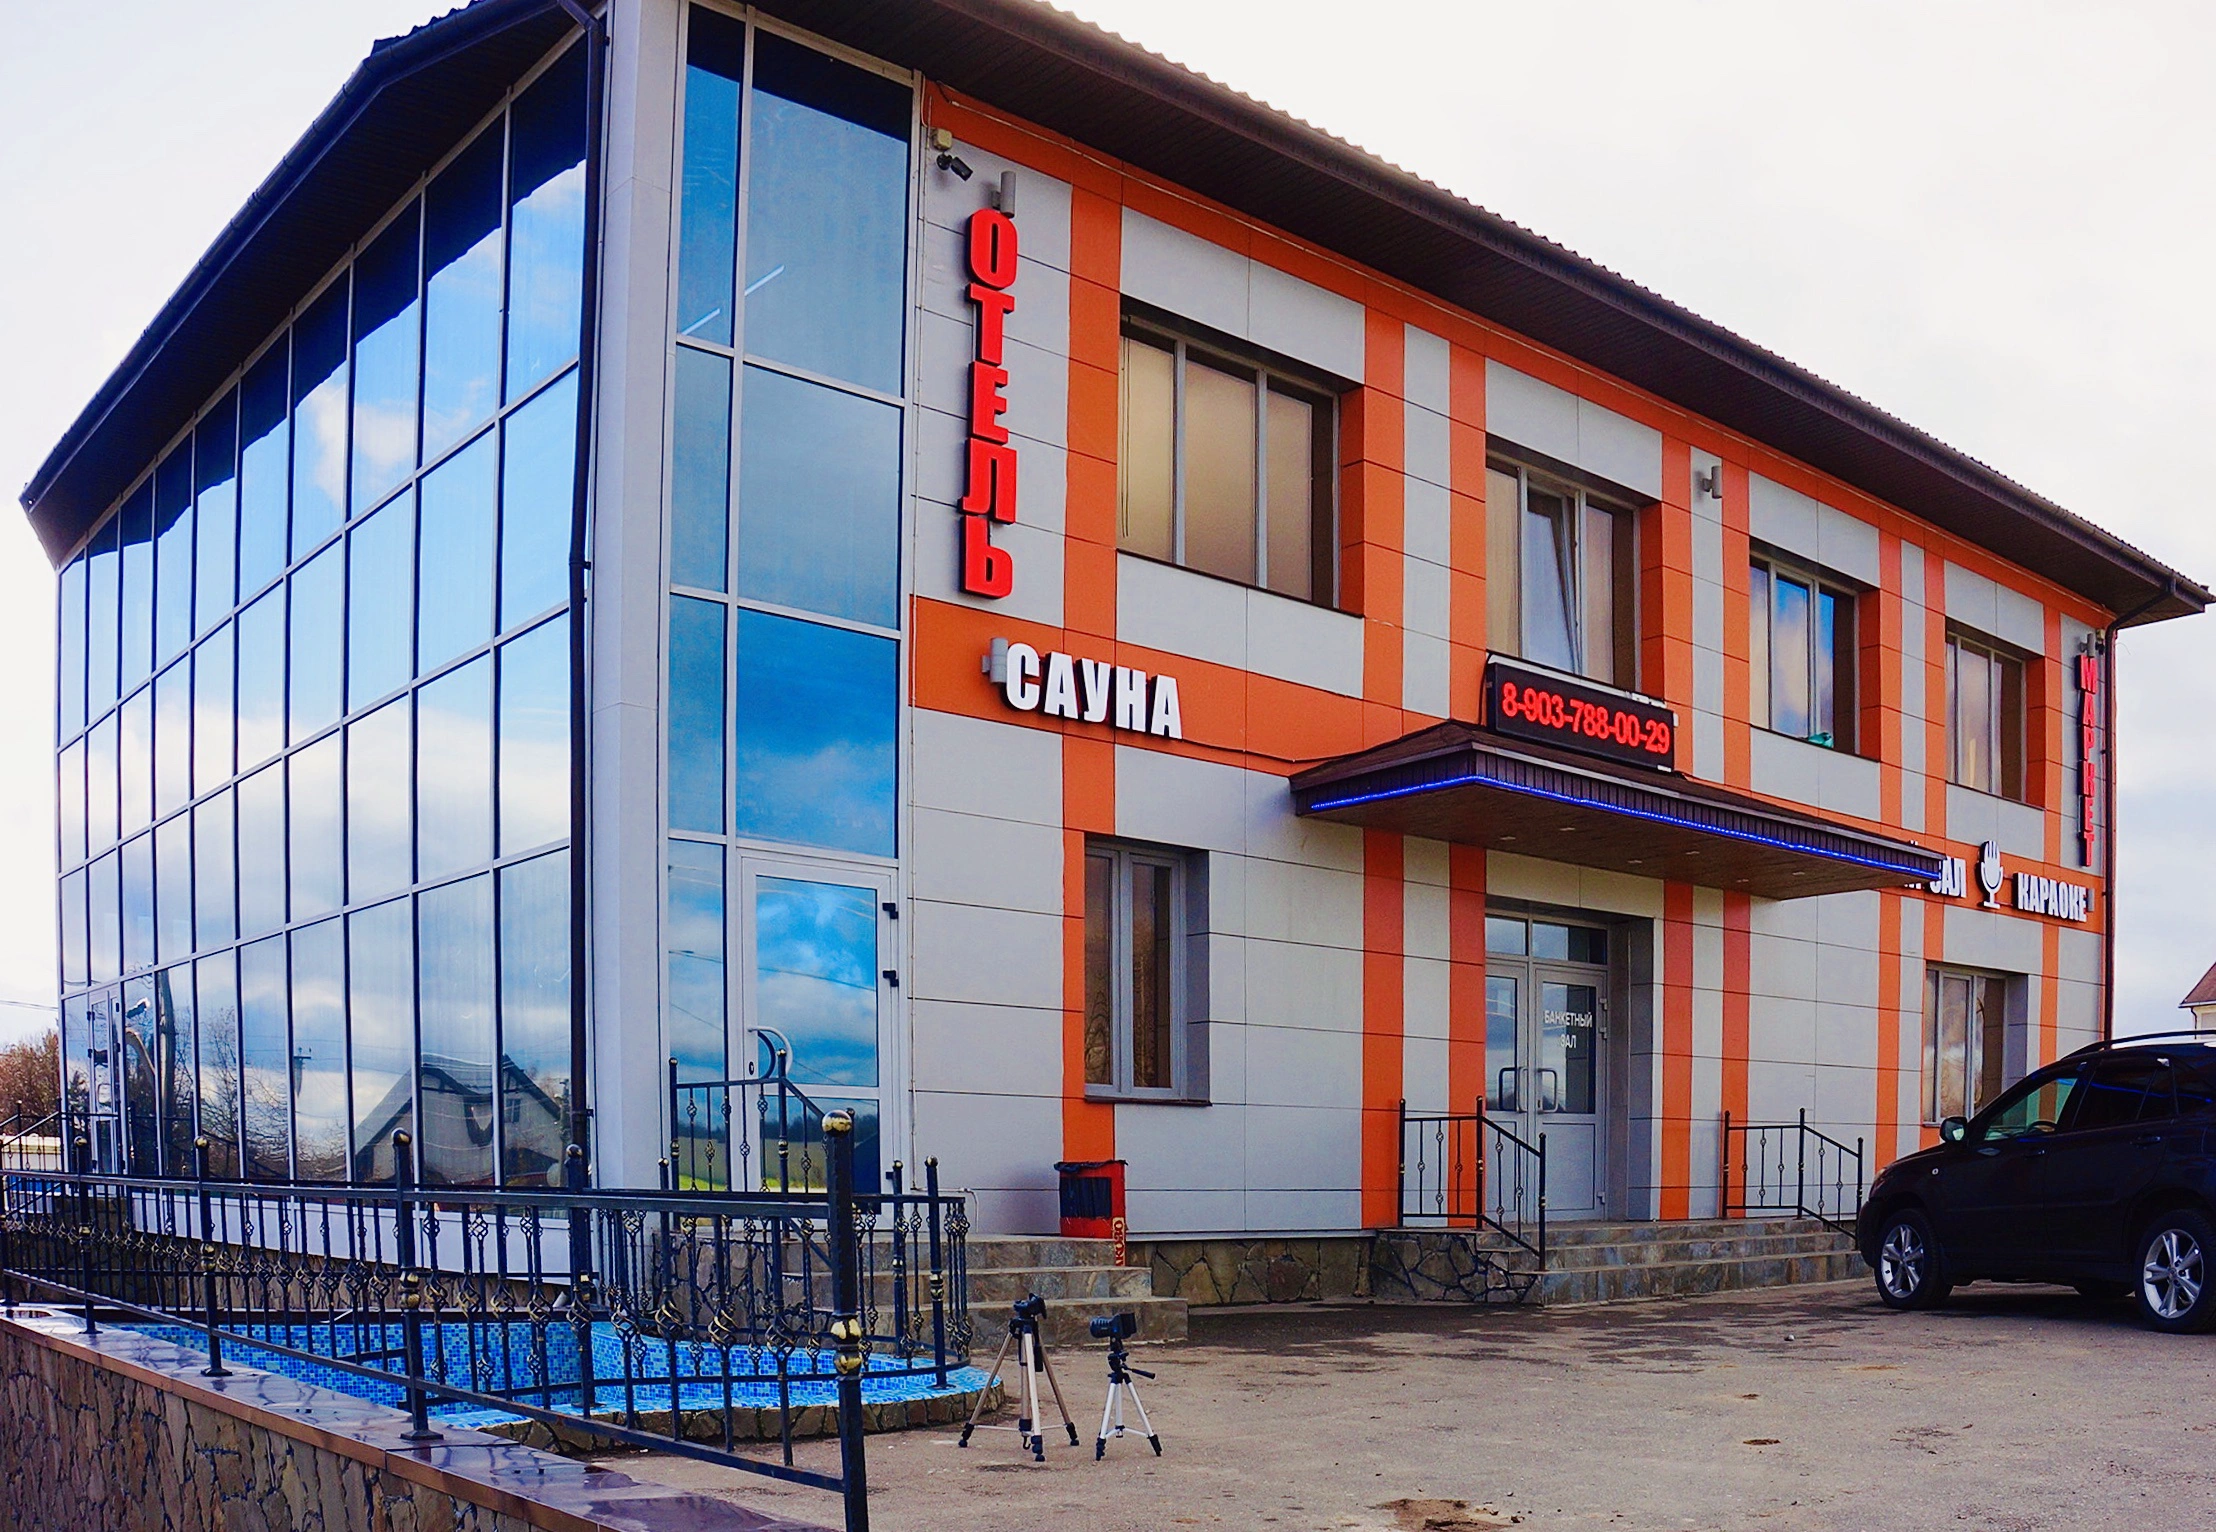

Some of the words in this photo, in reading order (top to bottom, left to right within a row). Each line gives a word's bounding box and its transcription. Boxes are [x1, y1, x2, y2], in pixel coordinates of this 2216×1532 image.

[960, 208, 1017, 599] ОТЕЛЬ
[1006, 642, 1182, 739] САУНА
[1502, 682, 1670, 754] 8-903-788-00-29
[2078, 655, 2097, 867] МАРКЕТ
[2017, 872, 2087, 922] КАРАОКЕ
[1544, 1010, 1593, 1028] БАНКЕТНЫЙ
[1560, 1034, 1577, 1048] ЗАЛ
